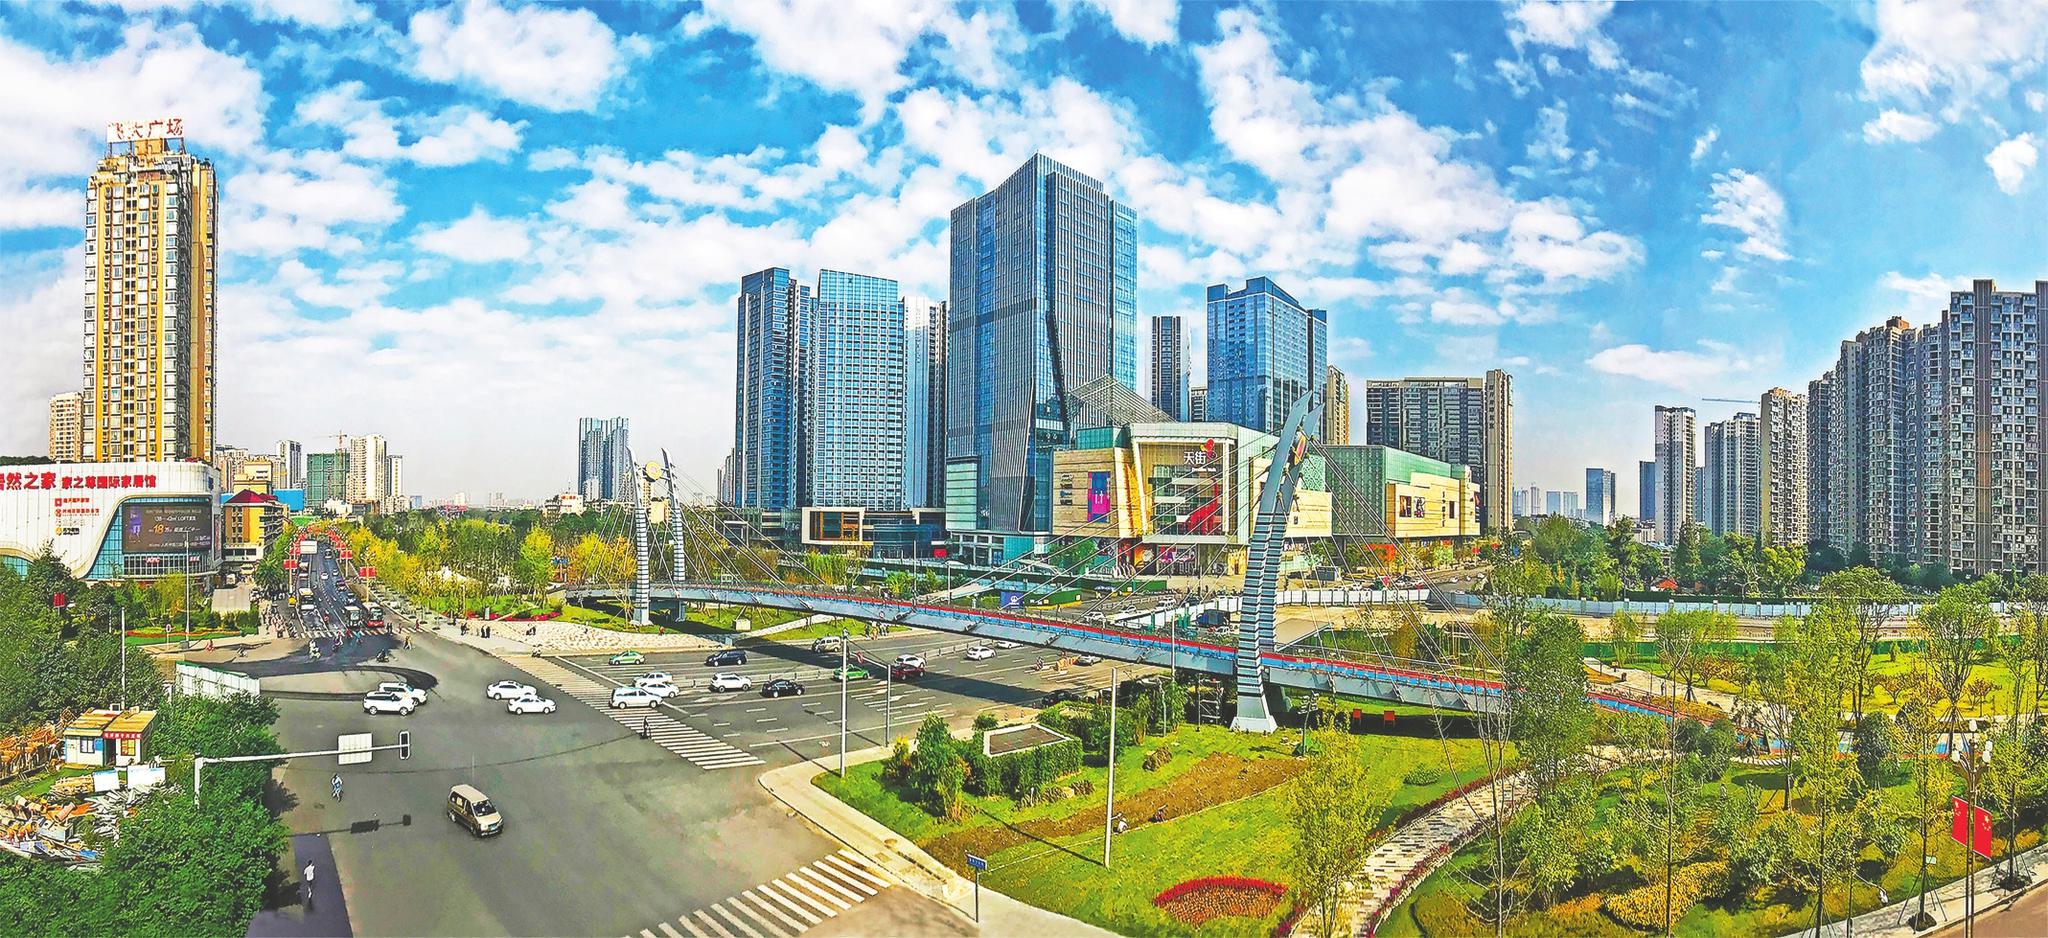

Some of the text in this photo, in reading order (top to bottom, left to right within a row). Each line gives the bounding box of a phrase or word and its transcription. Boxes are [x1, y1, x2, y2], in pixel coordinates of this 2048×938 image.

[1184, 451, 1206, 465] 天街
[61, 474, 157, 489] 家之尊国际家居馆
